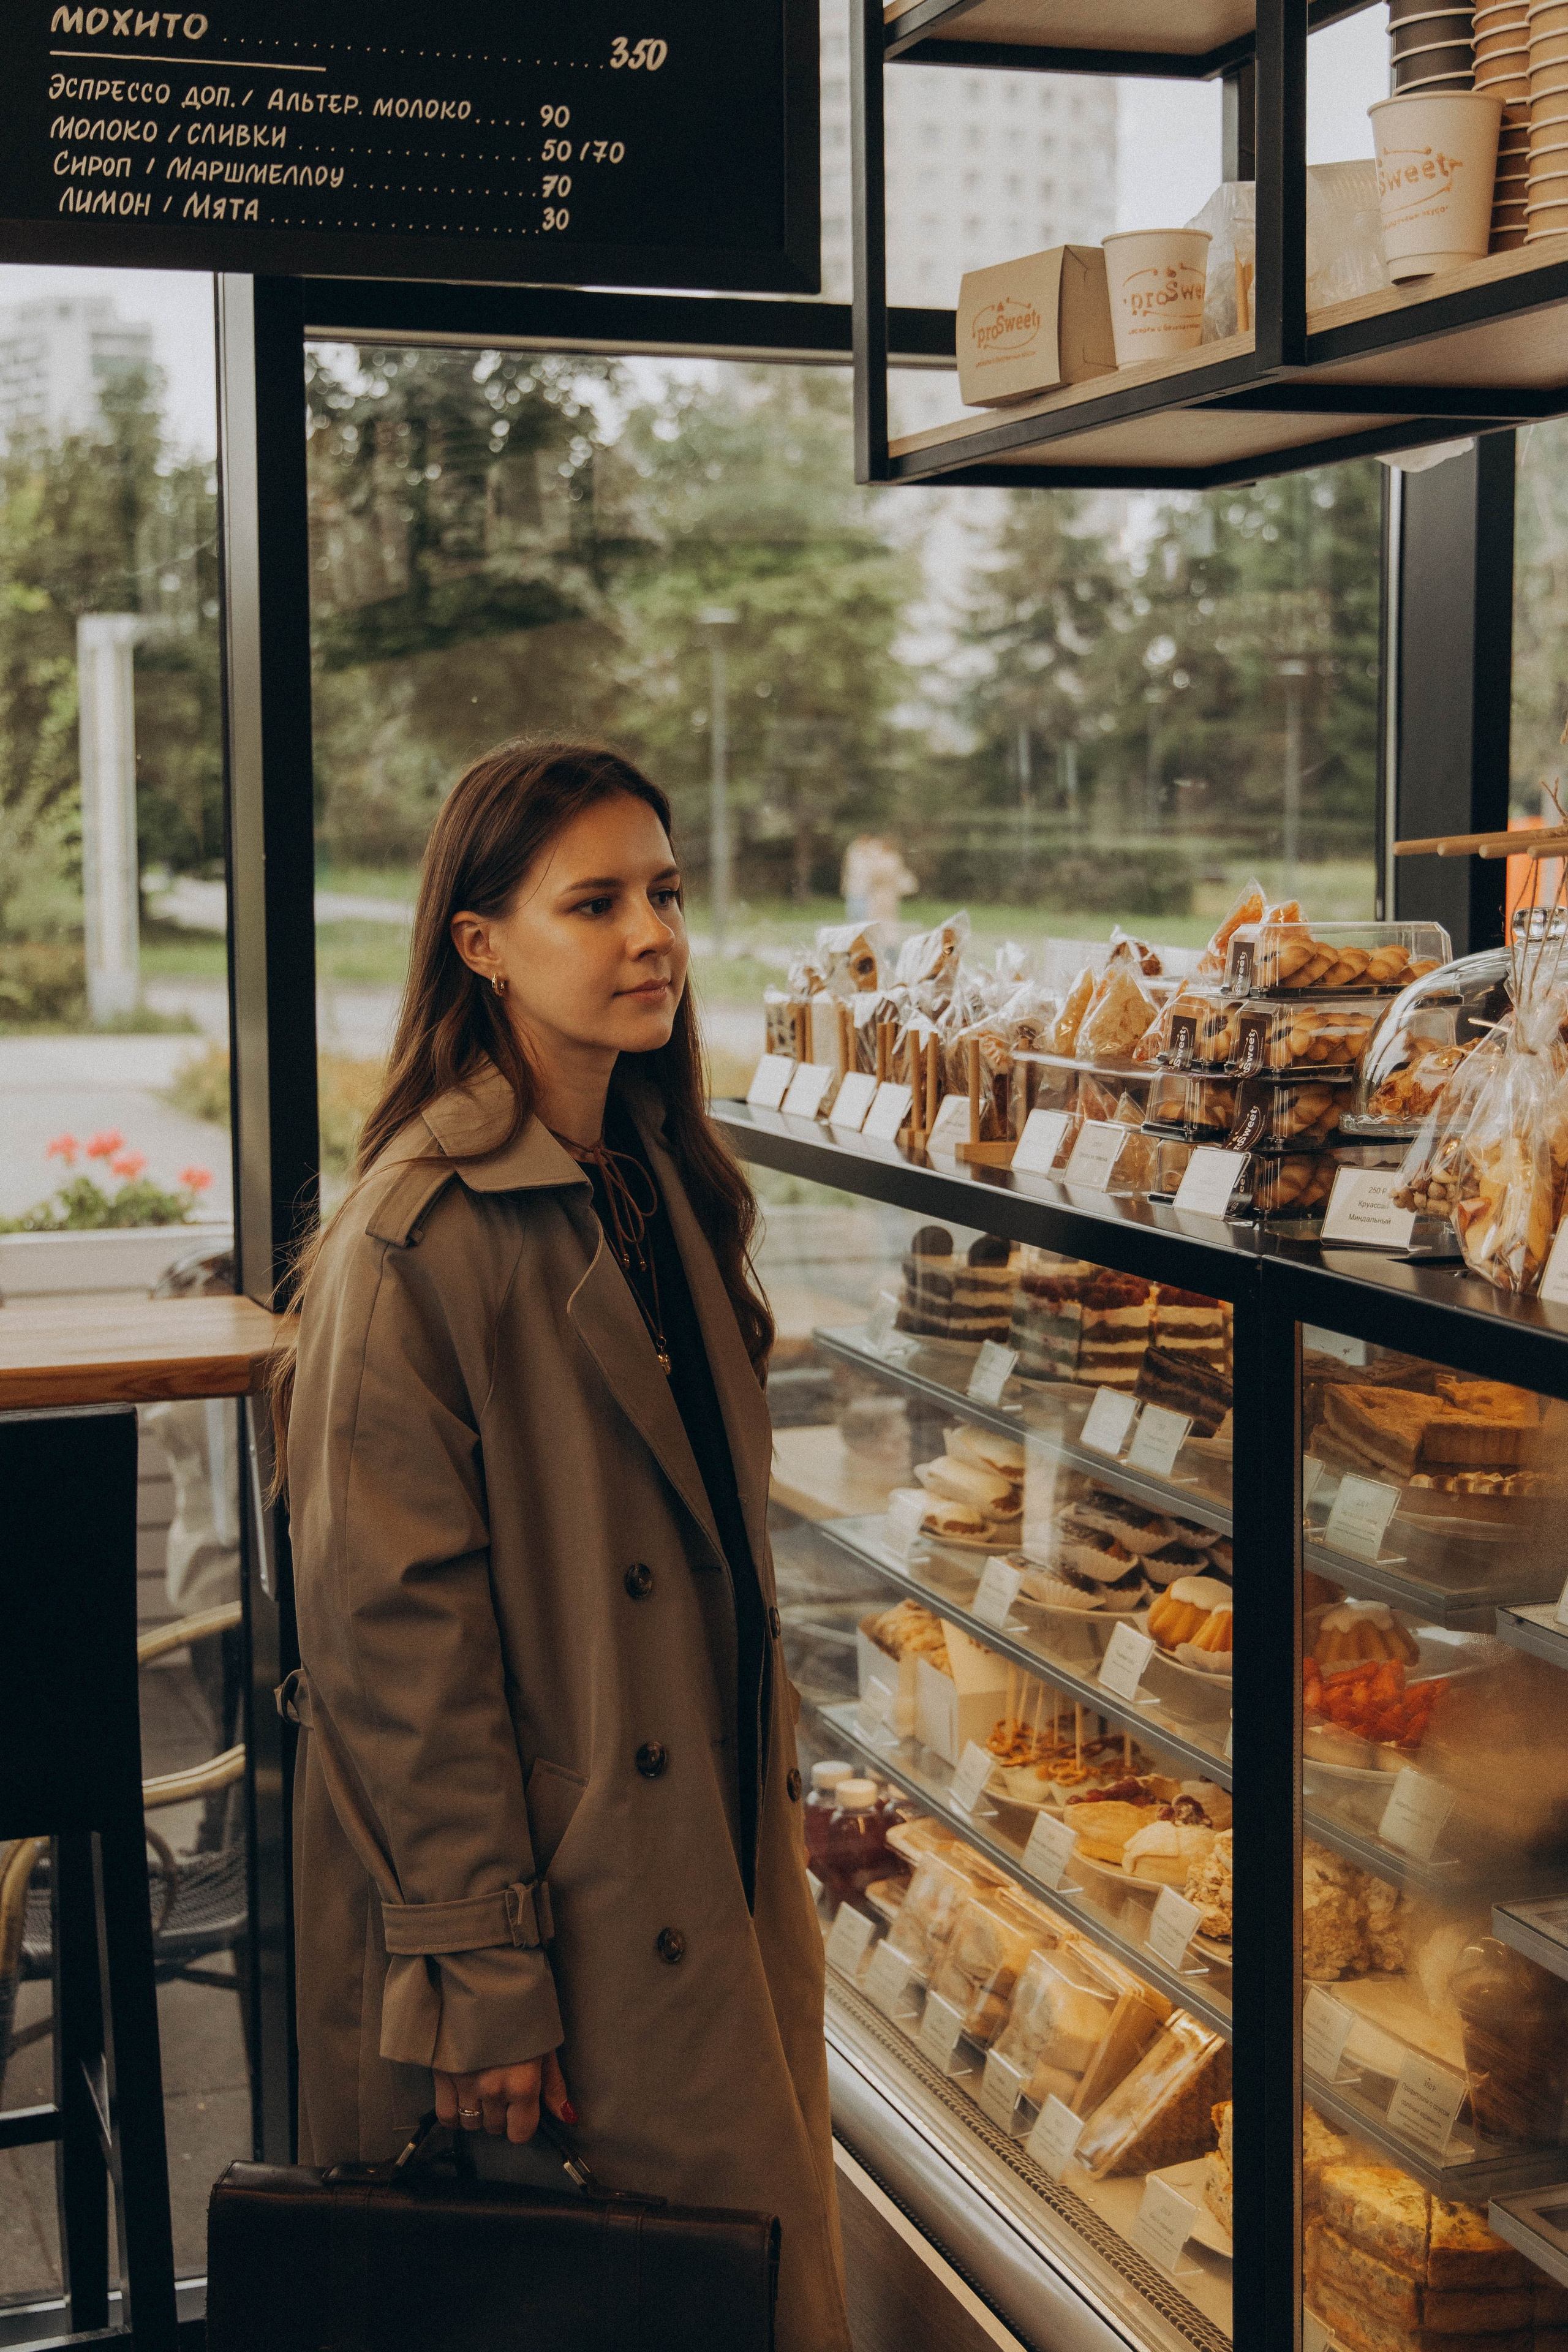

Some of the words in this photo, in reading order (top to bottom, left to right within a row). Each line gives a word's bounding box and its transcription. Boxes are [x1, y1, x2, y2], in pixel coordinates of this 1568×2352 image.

[50, 5, 208, 40] МОХИТО
[609, 36, 668, 71] 350
[540, 104, 570, 128] 90
[542, 175, 572, 198] 70
[542, 206, 570, 231] 30
[1131, 280, 1205, 317] proSwe
[978, 309, 1036, 349] proSweet
[1233, 1109, 1257, 1150] roSweet
[1368, 1186, 1381, 1195] 250
[1348, 1213, 1392, 1225] Миндальный
